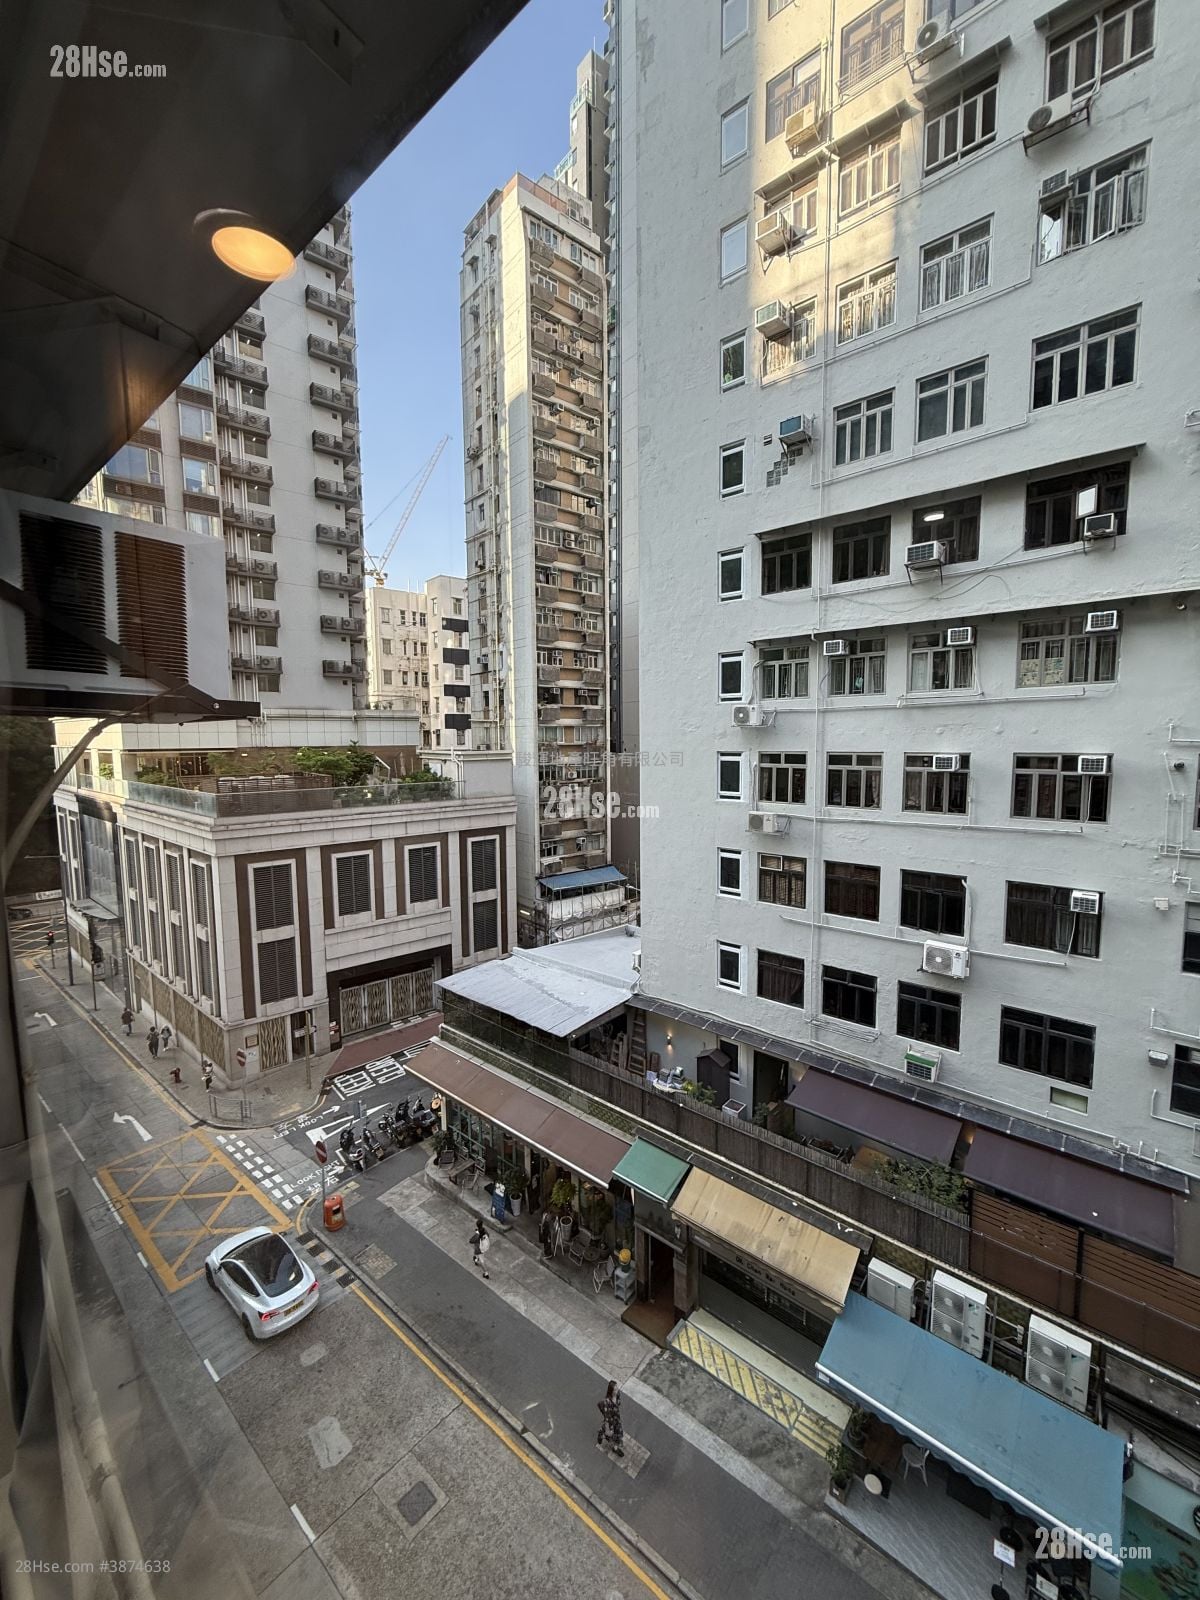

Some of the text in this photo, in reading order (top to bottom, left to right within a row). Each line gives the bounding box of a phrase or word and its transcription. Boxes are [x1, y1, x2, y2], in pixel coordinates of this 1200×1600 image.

[334, 1070, 376, 1097] KEEP
[365, 1055, 407, 1084] CLEAR
[272, 1115, 324, 1140] LOOK LEFT
[290, 1159, 340, 1188] LOOK RGHT
